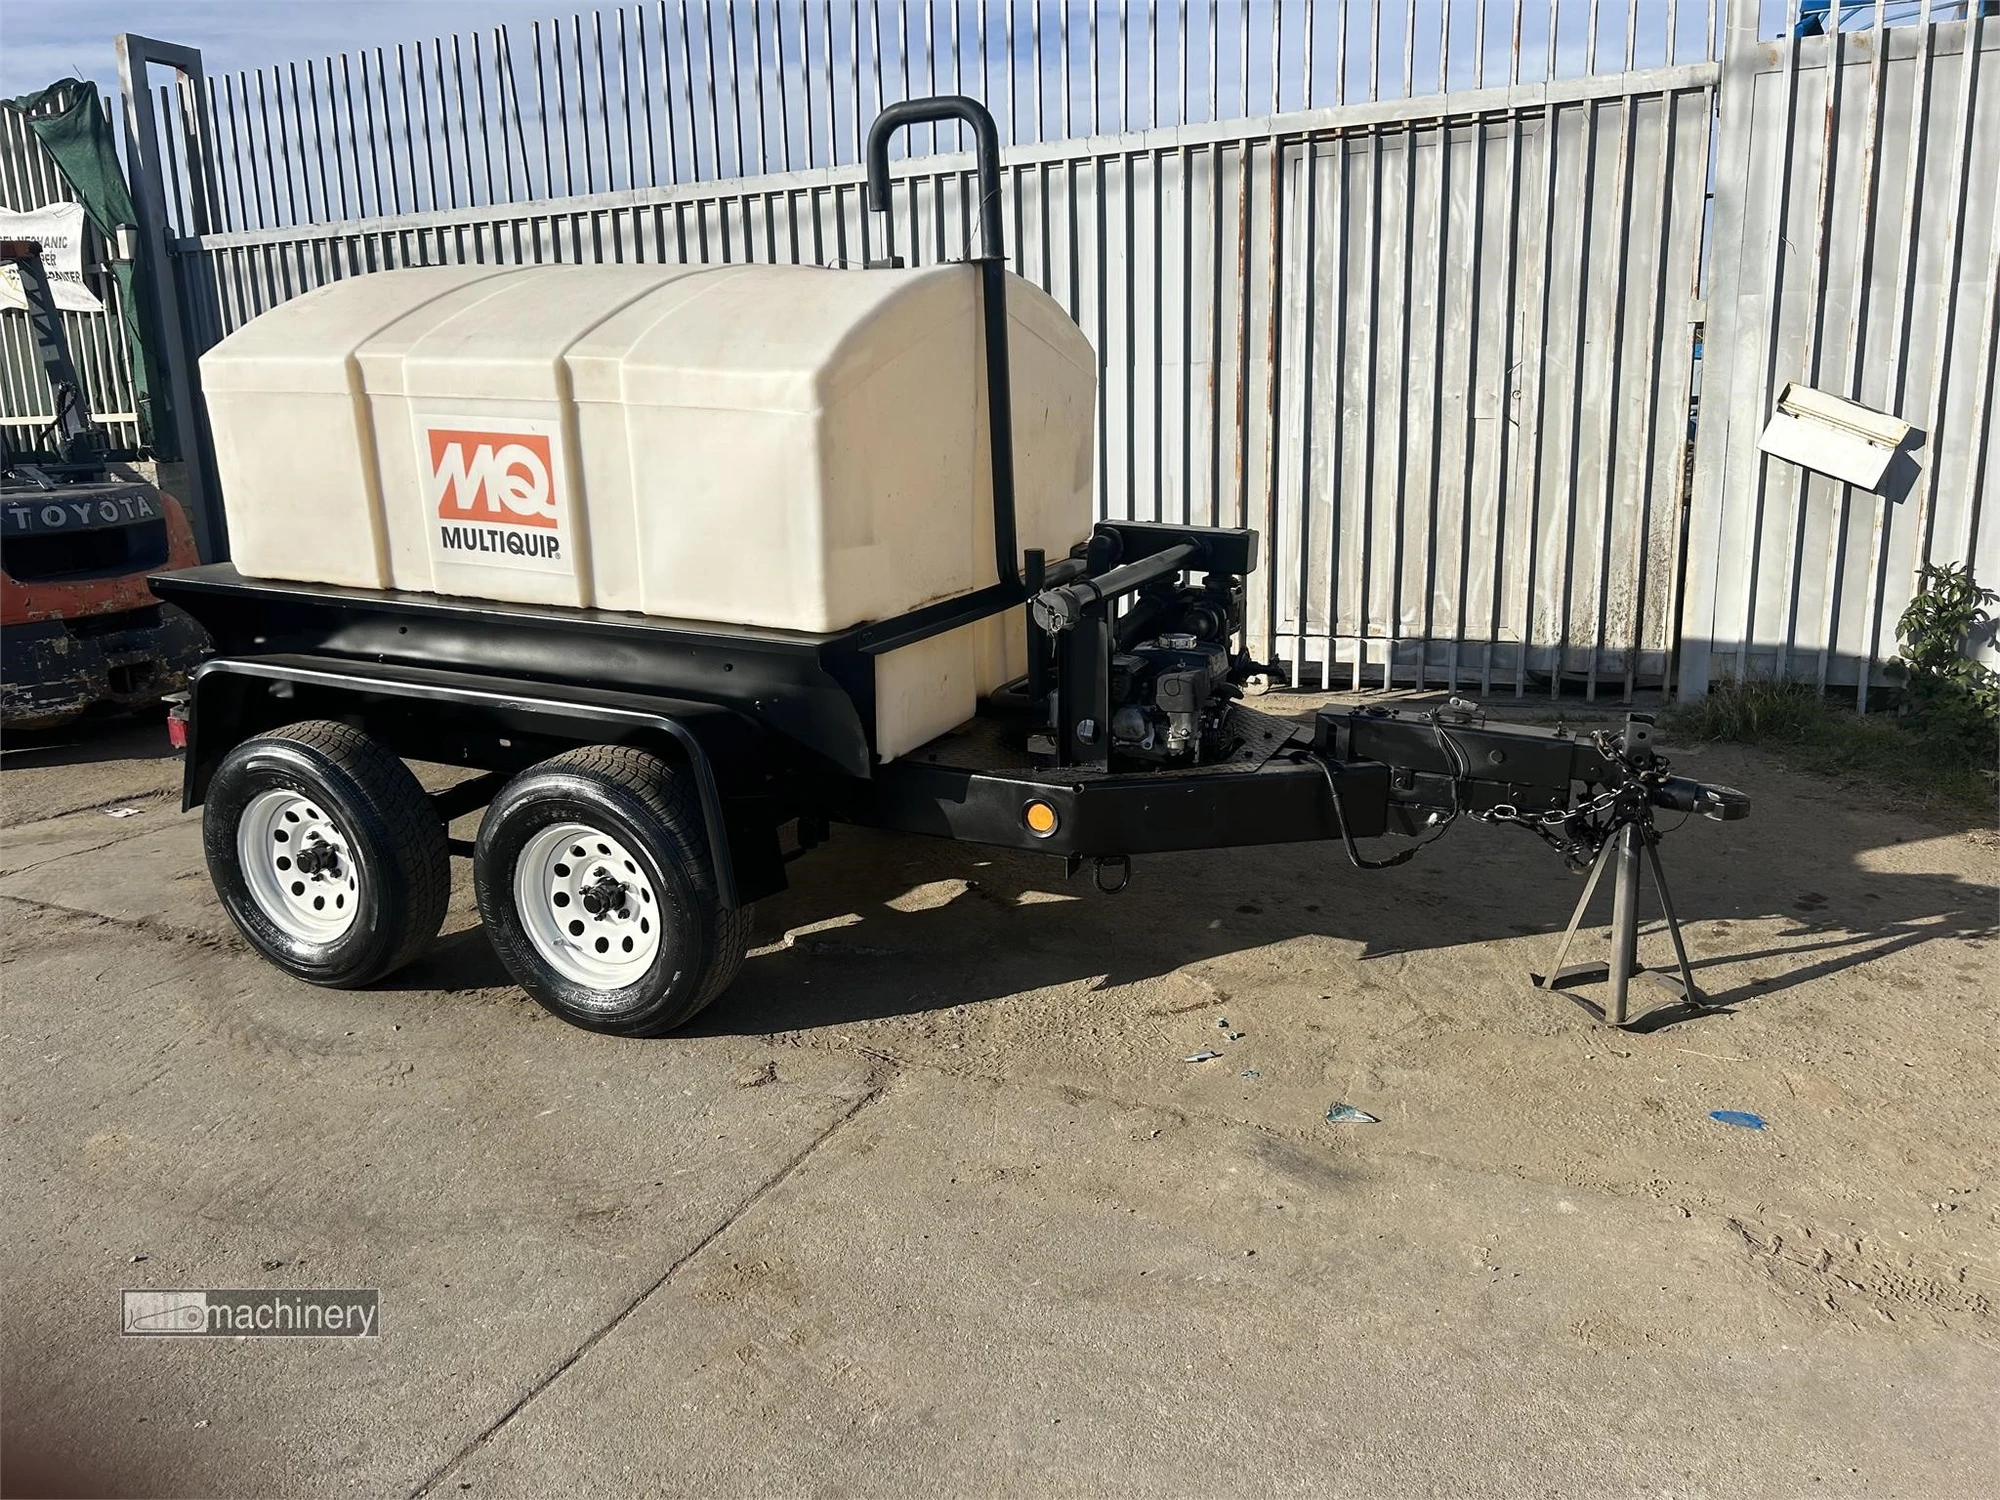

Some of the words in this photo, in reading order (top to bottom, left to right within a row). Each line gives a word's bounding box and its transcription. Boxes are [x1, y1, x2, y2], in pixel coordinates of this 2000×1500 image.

[433, 442, 558, 520] MQ
[8, 495, 154, 530] TOYOTA
[441, 527, 560, 558] MULTIQUIP
